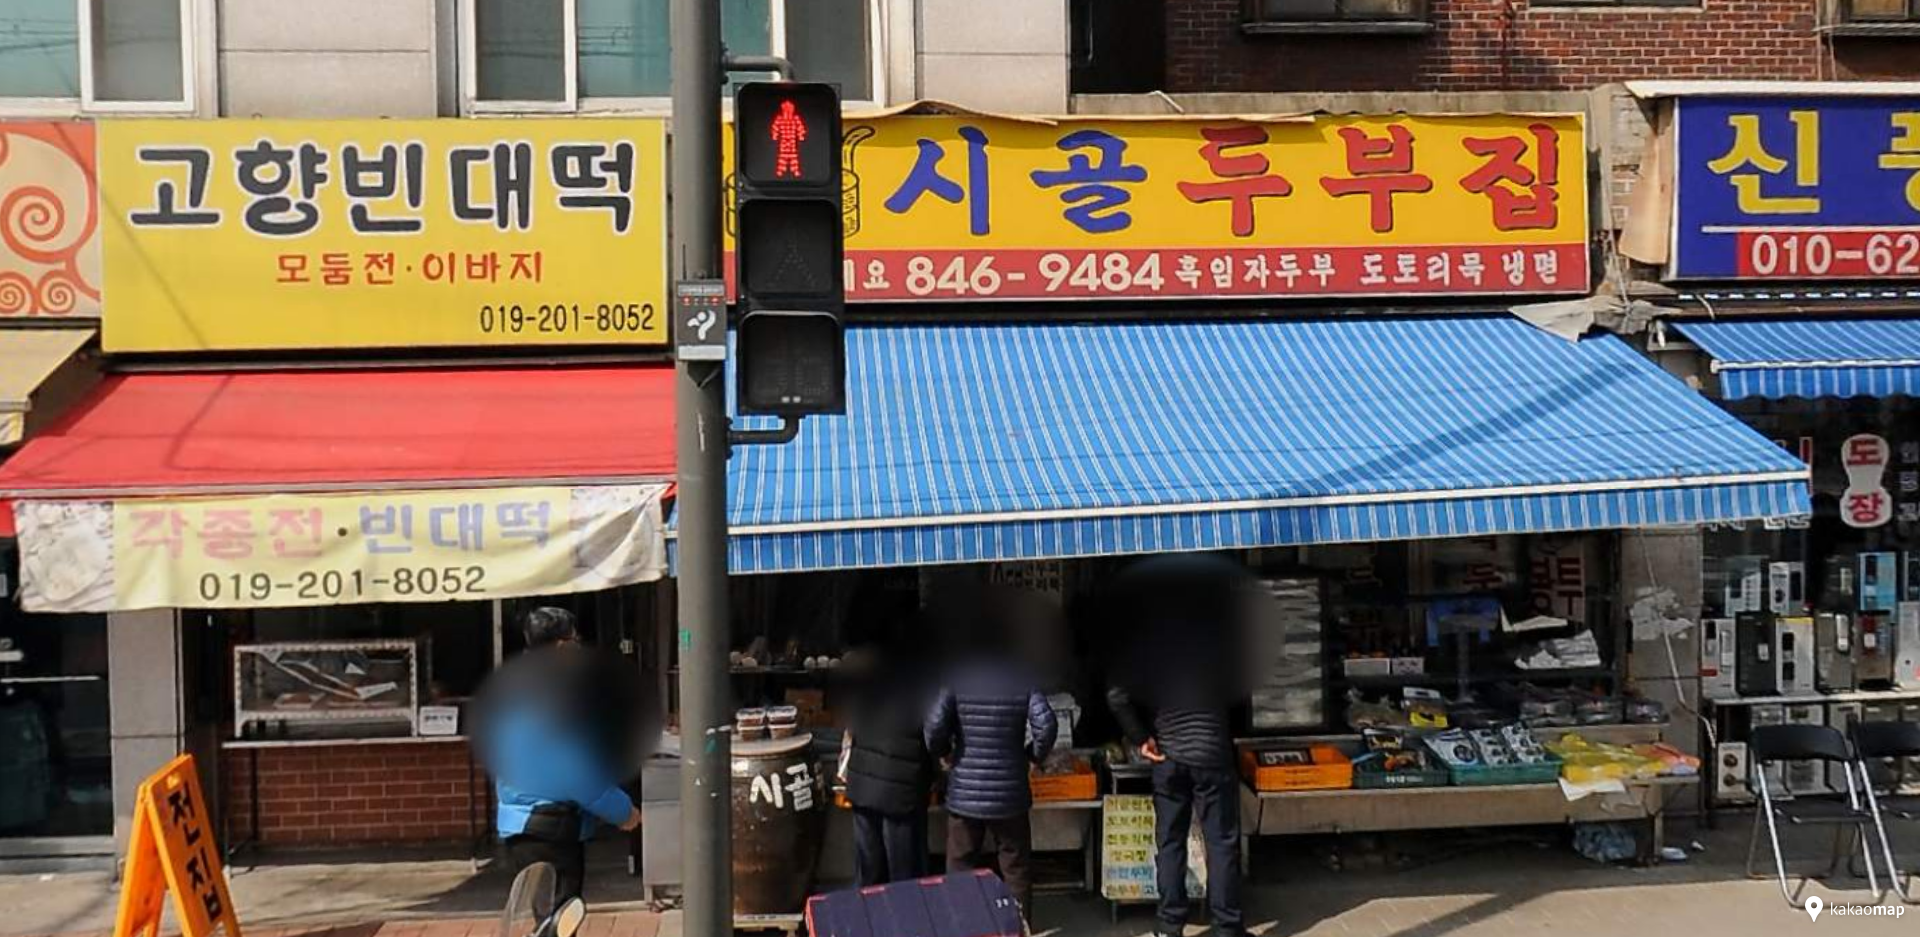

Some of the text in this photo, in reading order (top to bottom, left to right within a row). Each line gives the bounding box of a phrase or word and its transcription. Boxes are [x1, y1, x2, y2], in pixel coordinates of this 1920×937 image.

[130, 139, 635, 236] 고향빈대떡
[1174, 253, 1337, 290] 흑임자두부
[1359, 251, 1486, 287] 도토리묵
[1501, 249, 1559, 287] 냉면
[1751, 233, 1920, 275] 010-62
[479, 303, 656, 334] 019-201-8052
[1846, 438, 1884, 523] 도장
[198, 564, 488, 602] 019-201-8052
[749, 760, 815, 813] 시골
[167, 780, 224, 923] 전집
